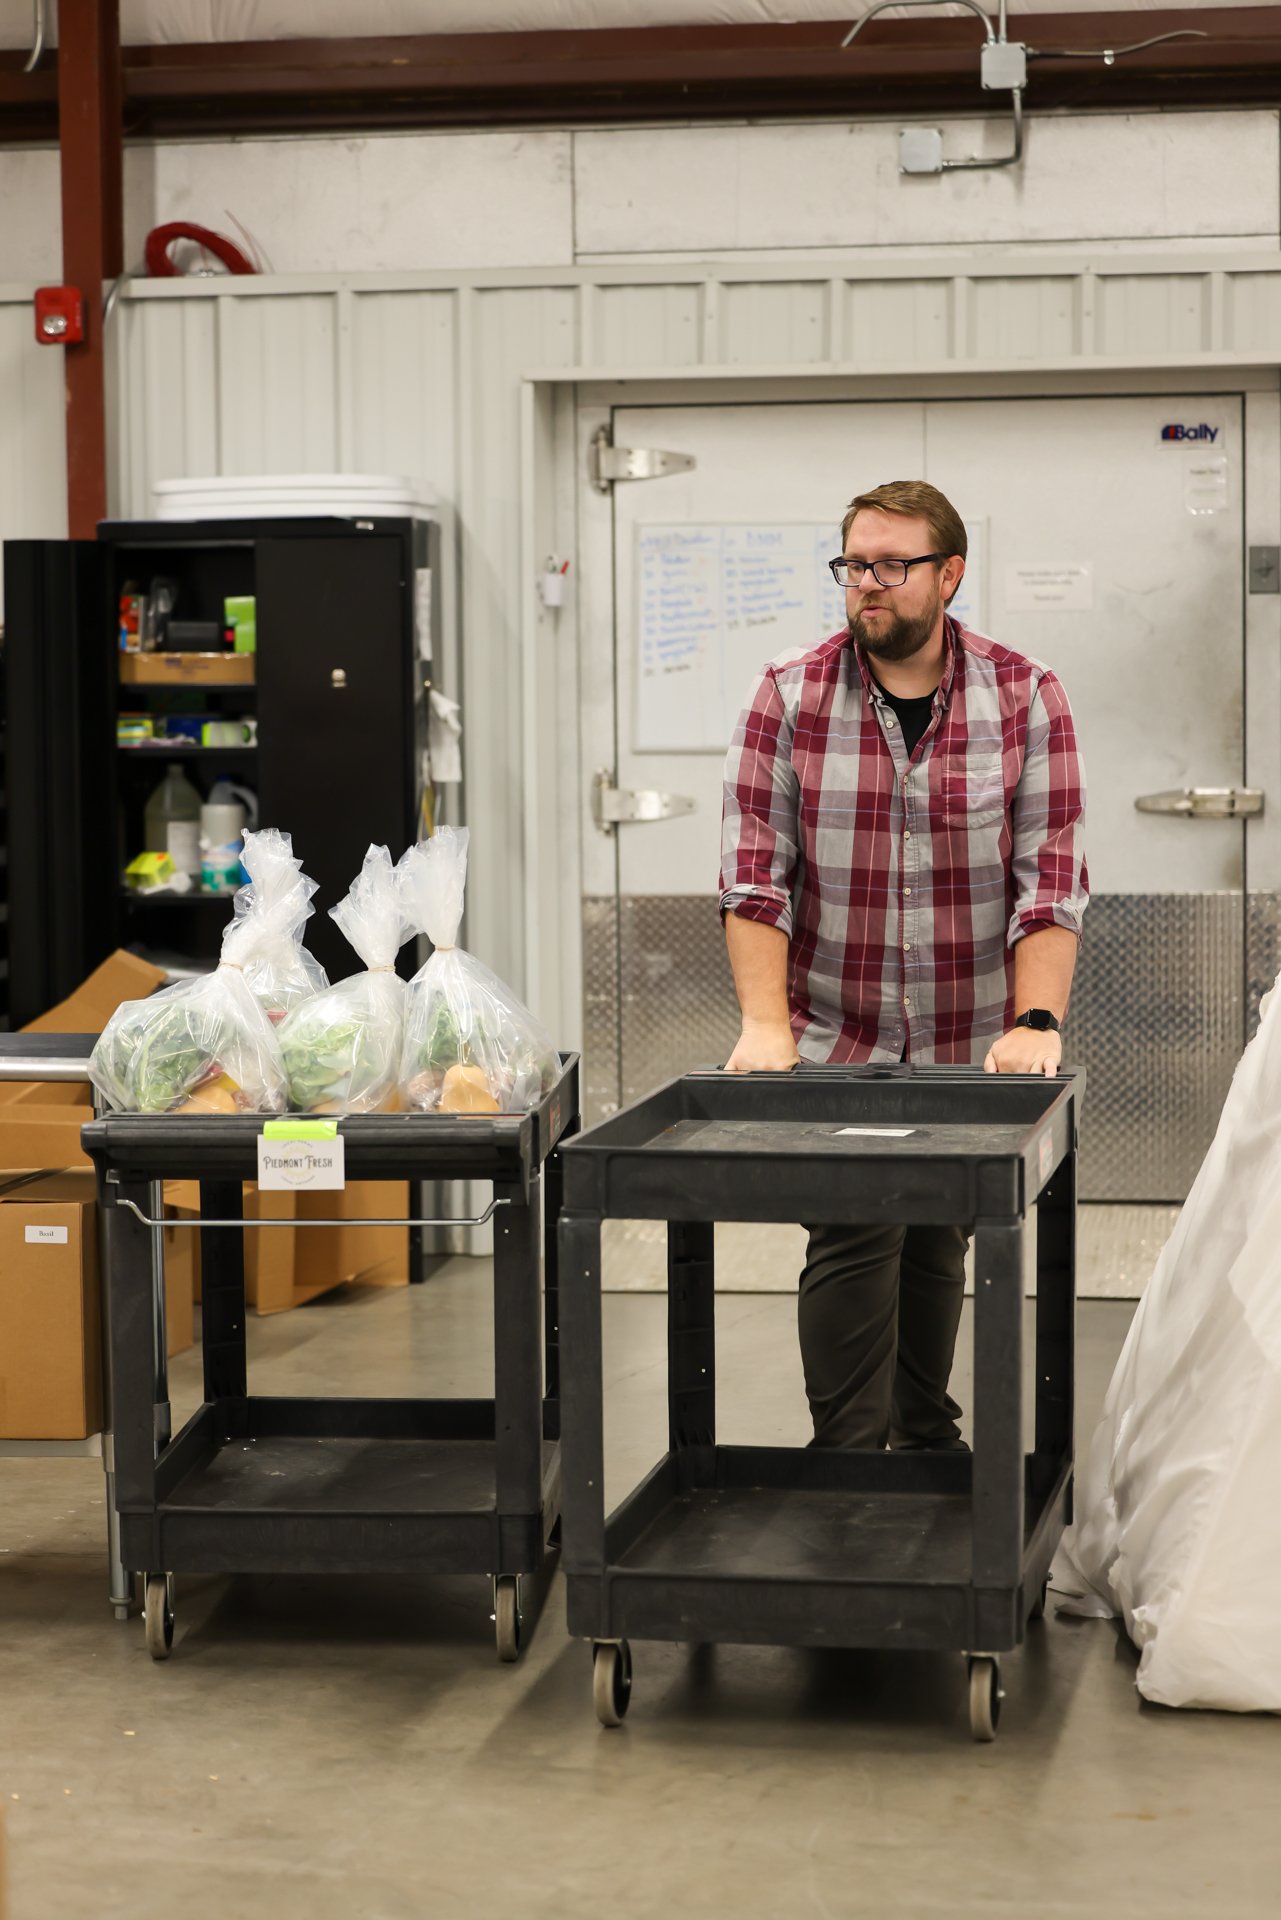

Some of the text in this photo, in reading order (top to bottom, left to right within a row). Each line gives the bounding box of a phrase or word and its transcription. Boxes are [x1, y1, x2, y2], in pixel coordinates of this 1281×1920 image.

[1168, 424, 1218, 443] Bally
[263, 1154, 333, 1170] PIEDMONT FRESH
